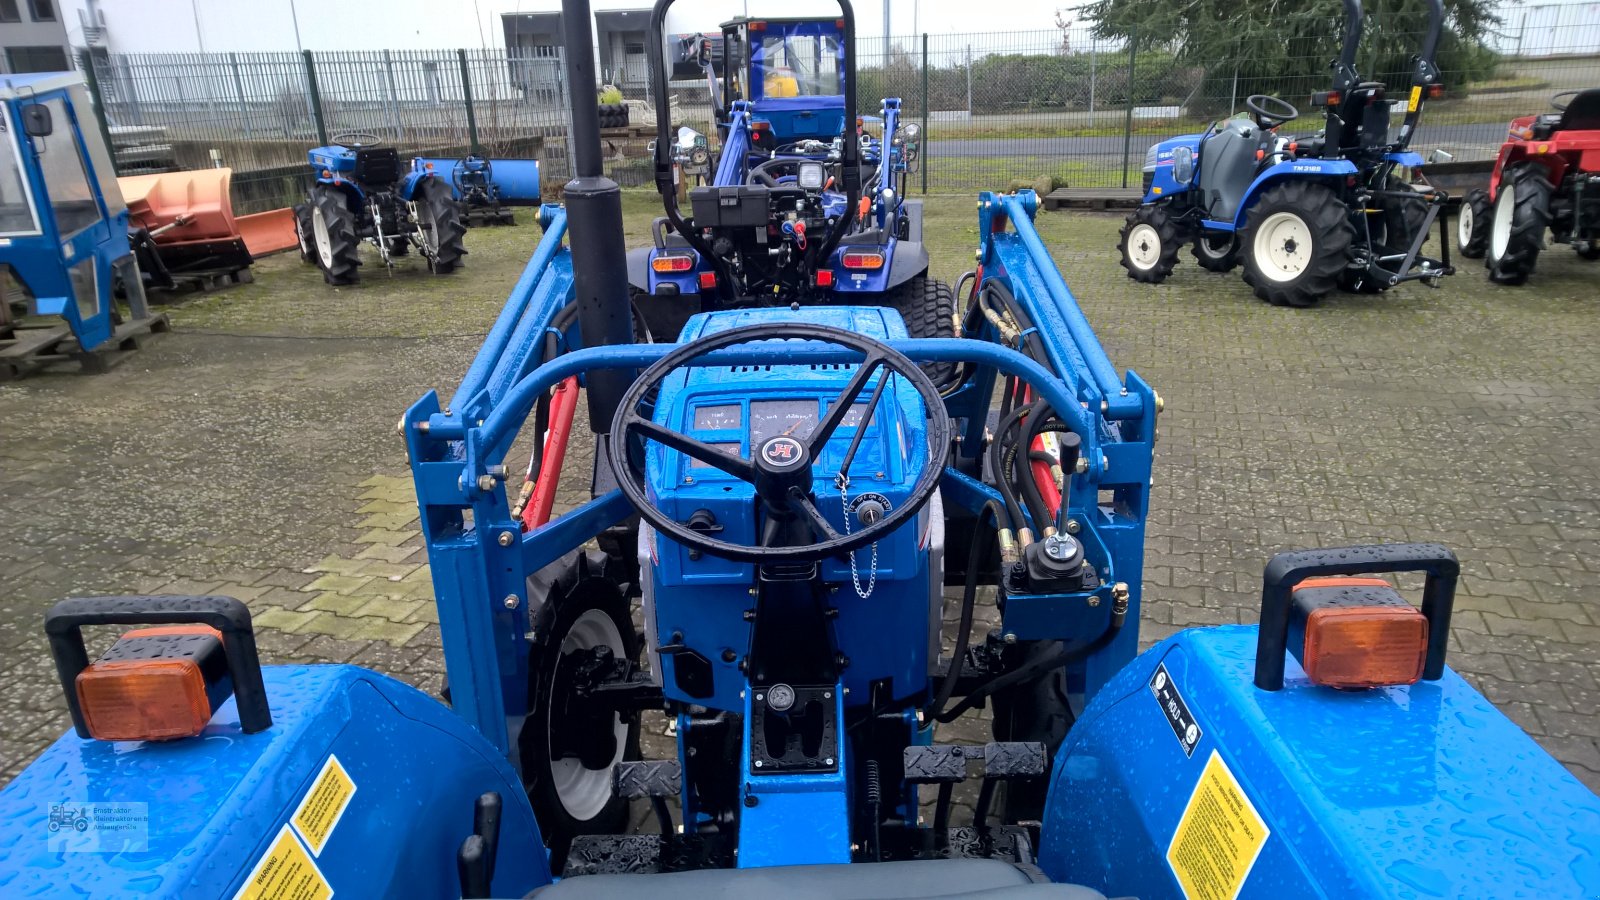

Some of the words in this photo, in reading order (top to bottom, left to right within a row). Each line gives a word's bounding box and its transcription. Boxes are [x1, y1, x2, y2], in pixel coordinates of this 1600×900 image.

[878, 497, 891, 510] START
[1168, 698, 1181, 720] HOLD
[257, 856, 277, 885] WARNING
